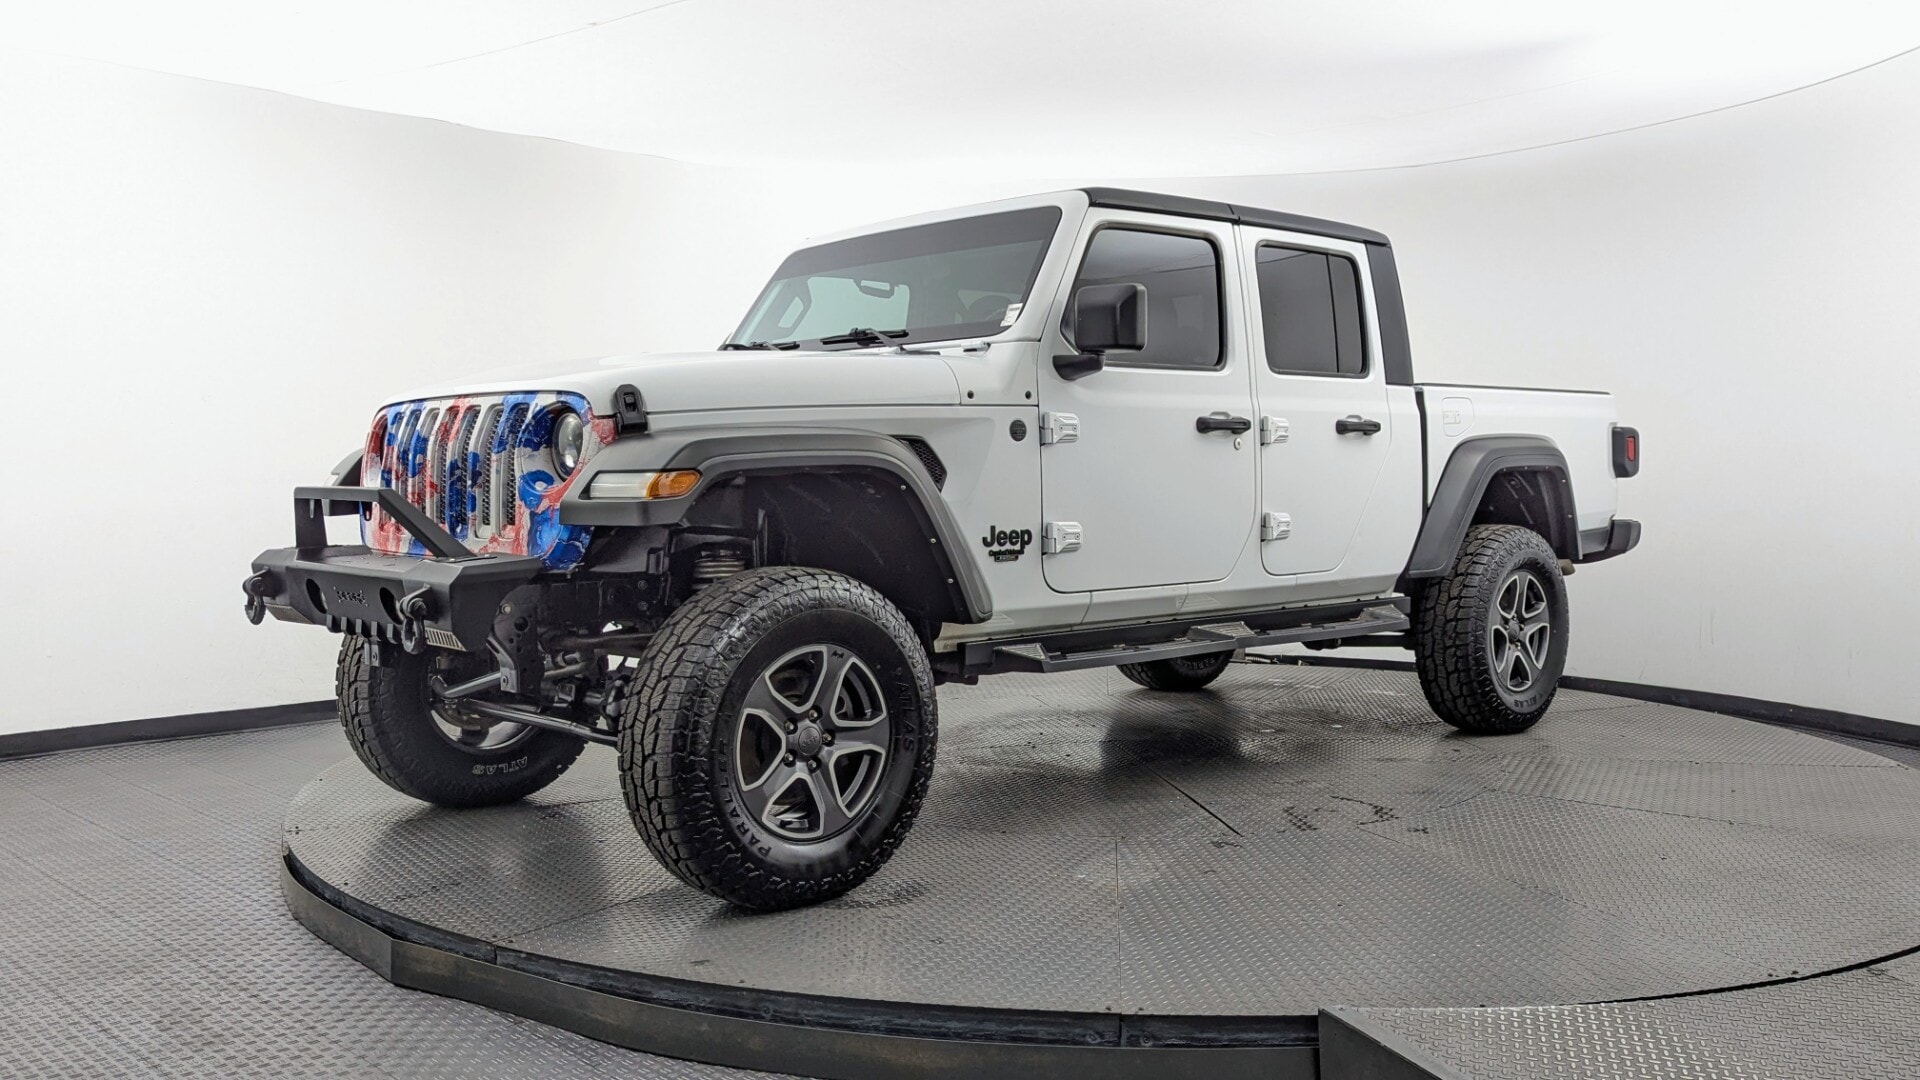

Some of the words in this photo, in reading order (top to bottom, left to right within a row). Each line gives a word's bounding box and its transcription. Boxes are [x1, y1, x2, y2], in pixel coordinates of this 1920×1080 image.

[982, 525, 1033, 549] Jeep
[1513, 694, 1537, 708] ATLAS
[895, 681, 917, 752] ATLAS
[472, 756, 528, 775] ATLAS
